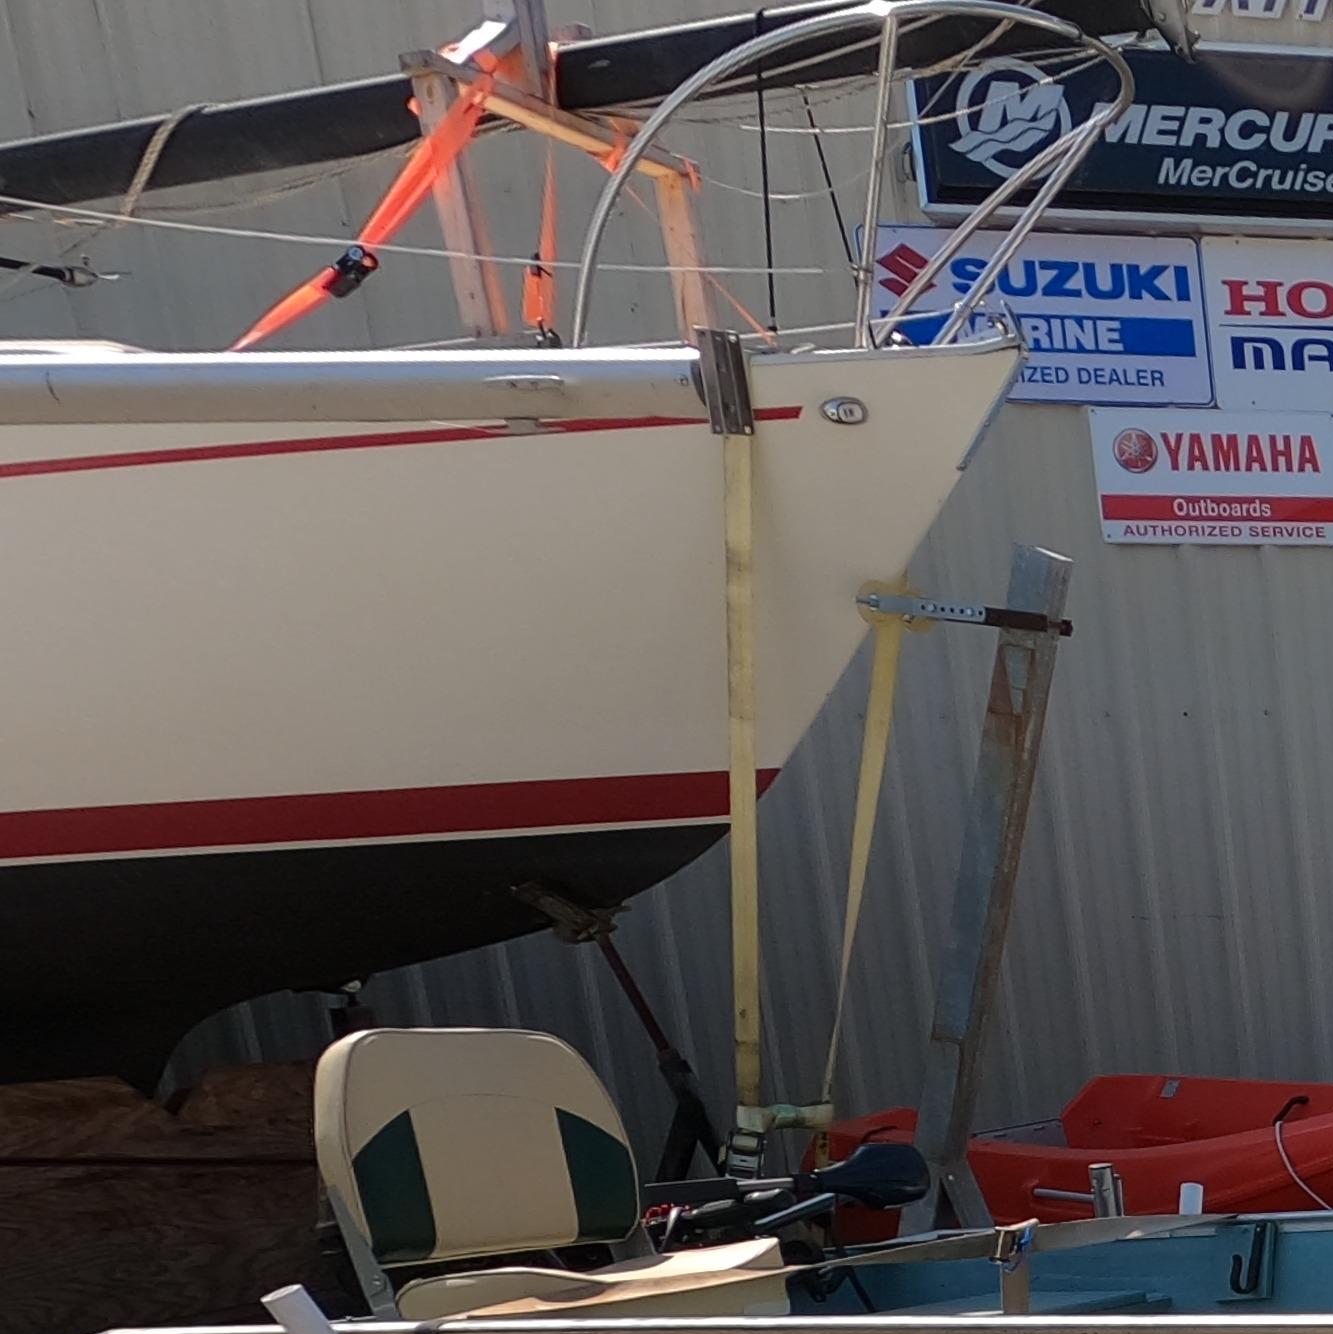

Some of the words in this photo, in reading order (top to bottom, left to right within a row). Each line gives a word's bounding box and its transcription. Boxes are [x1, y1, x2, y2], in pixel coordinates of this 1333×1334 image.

[950, 256, 1192, 302] SUZUKI
[1077, 366, 1166, 388] DEALER
[1159, 431, 1321, 474] YAMAHA
[1172, 498, 1272, 518] Outboards
[1123, 524, 1243, 538] AUTHORIZED
[1248, 525, 1326, 539] SERVICE
